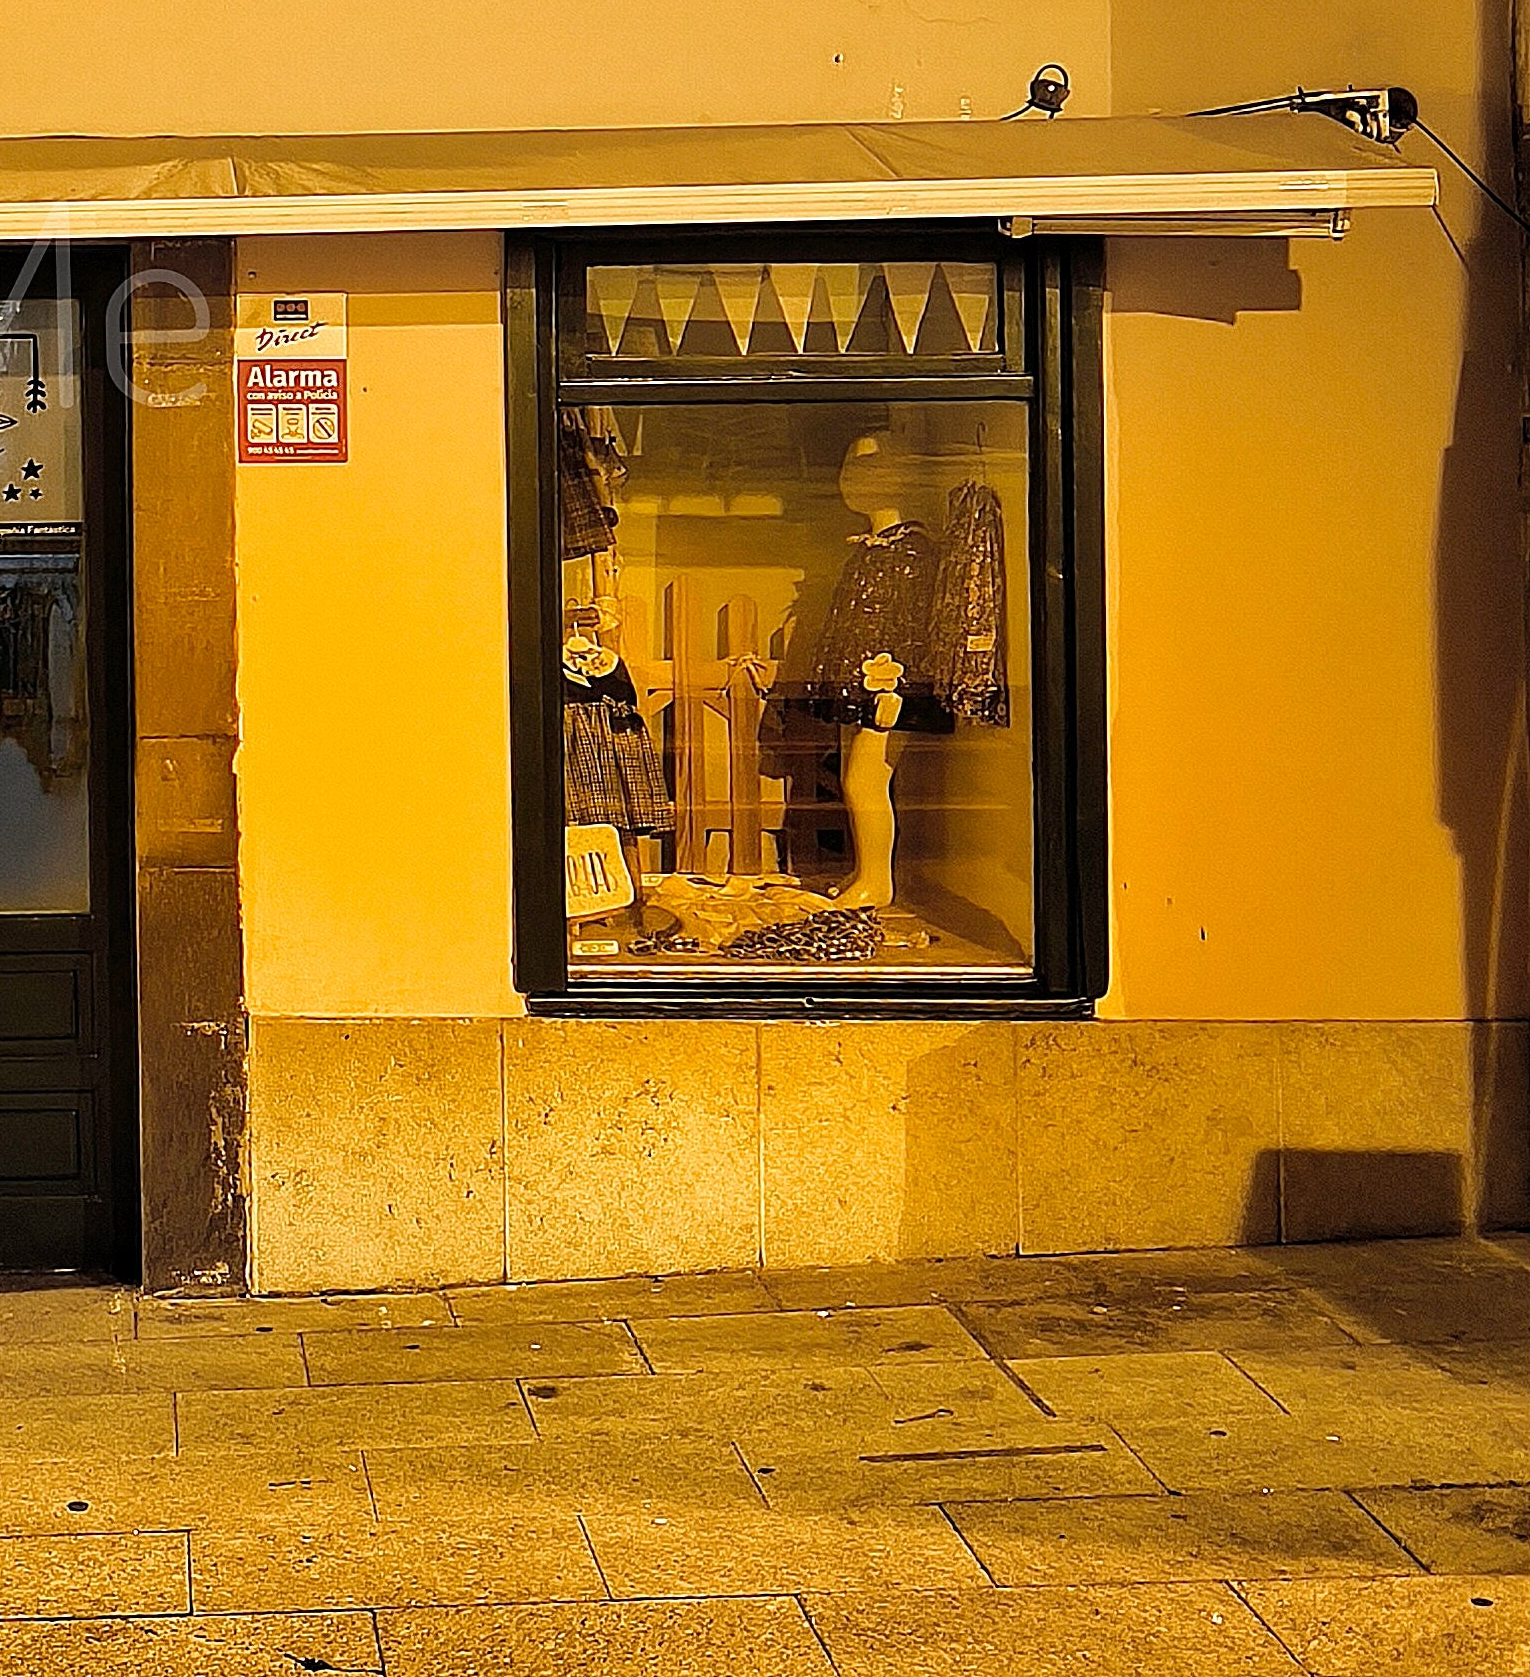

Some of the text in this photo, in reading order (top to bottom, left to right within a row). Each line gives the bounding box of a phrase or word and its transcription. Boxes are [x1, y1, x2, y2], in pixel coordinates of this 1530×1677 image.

[255, 321, 328, 351] Direct
[246, 364, 338, 387] Alarma
[247, 391, 265, 400] con
[266, 389, 293, 400] aviso
[295, 391, 302, 400] a
